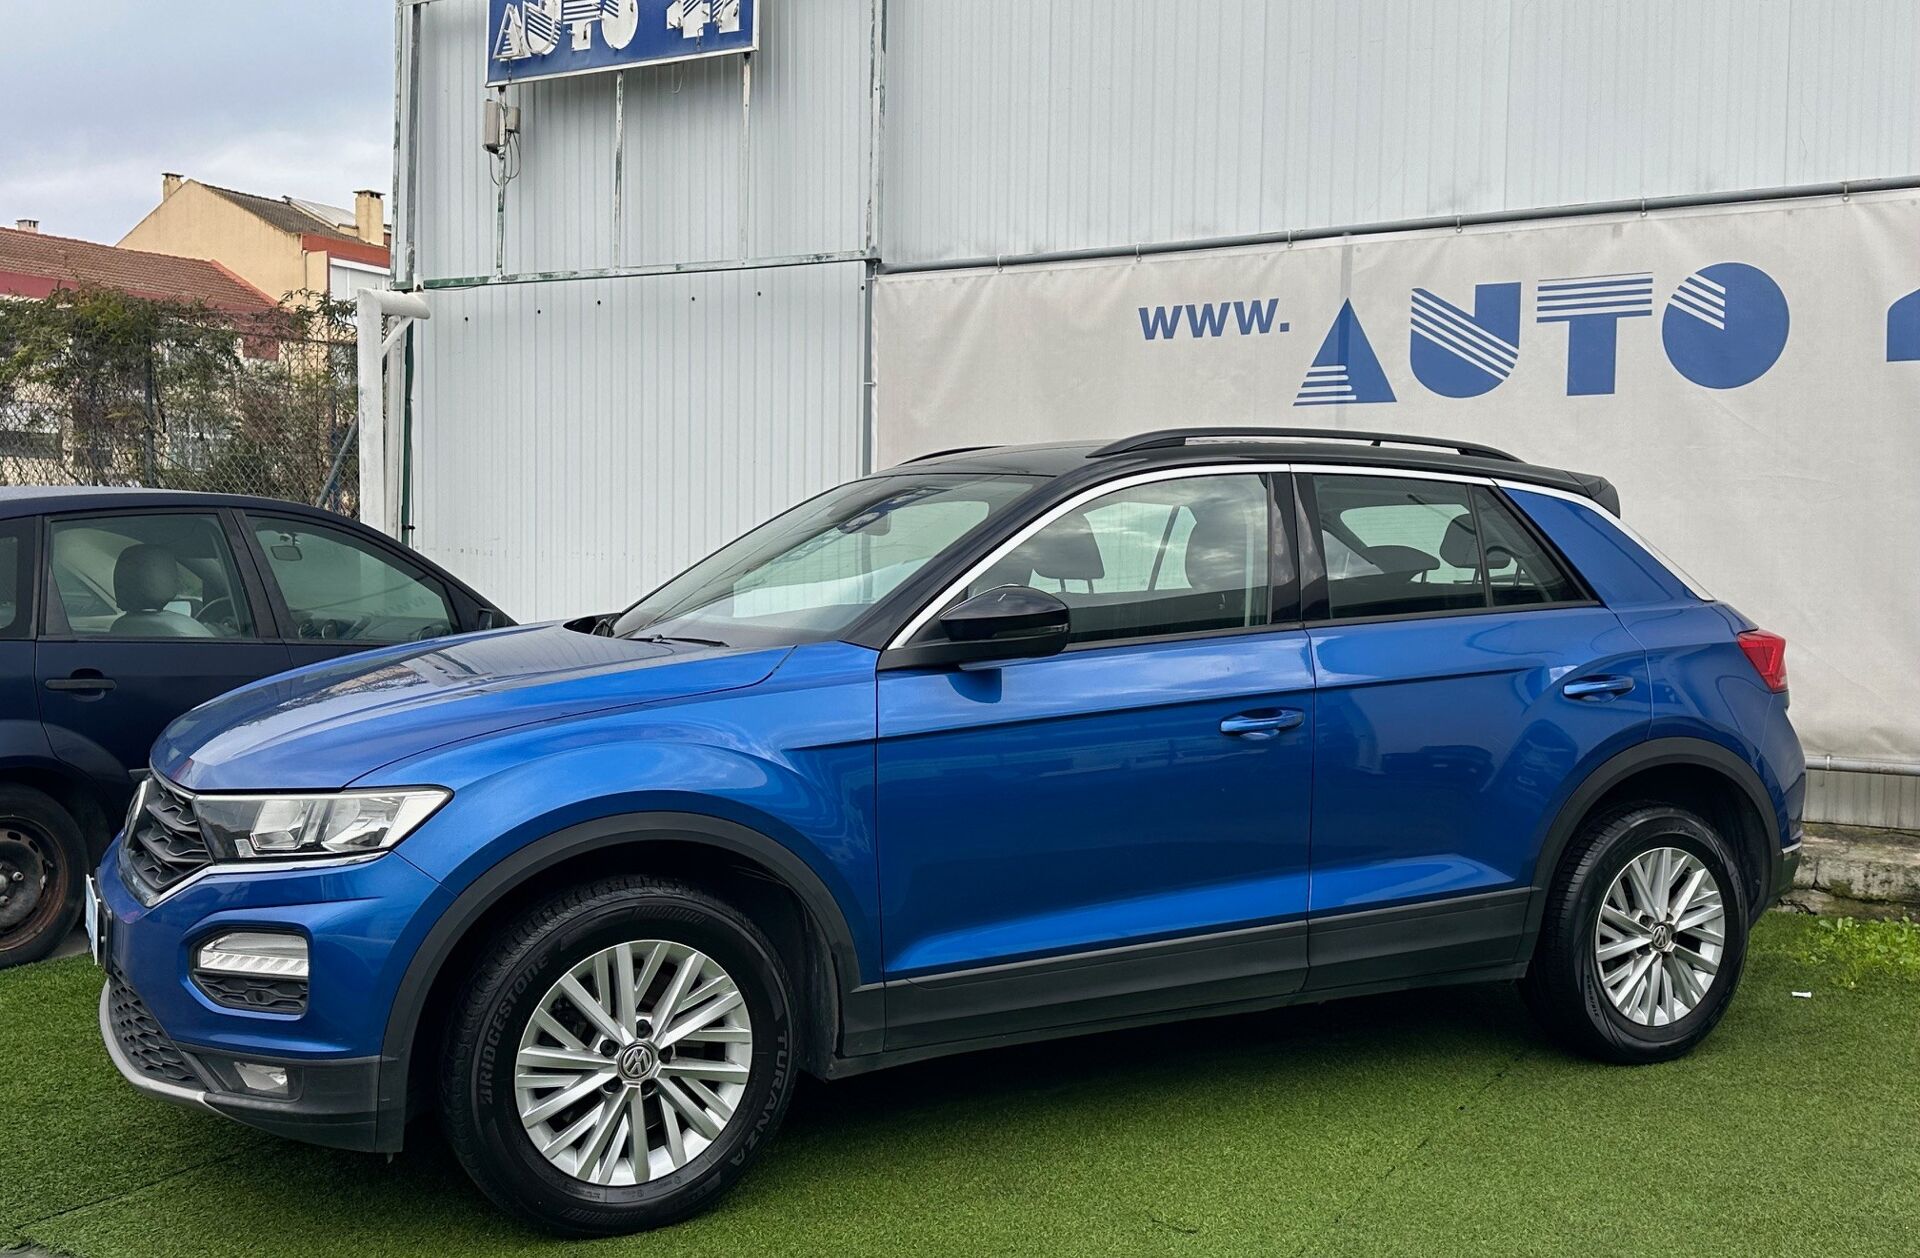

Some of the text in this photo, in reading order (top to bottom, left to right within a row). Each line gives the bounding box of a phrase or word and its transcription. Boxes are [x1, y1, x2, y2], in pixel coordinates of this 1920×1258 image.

[491, 0, 639, 62] AUTO
[1138, 298, 1291, 341] www.
[1293, 262, 1790, 406] AUTO
[729, 1029, 788, 1167] TURANZA
